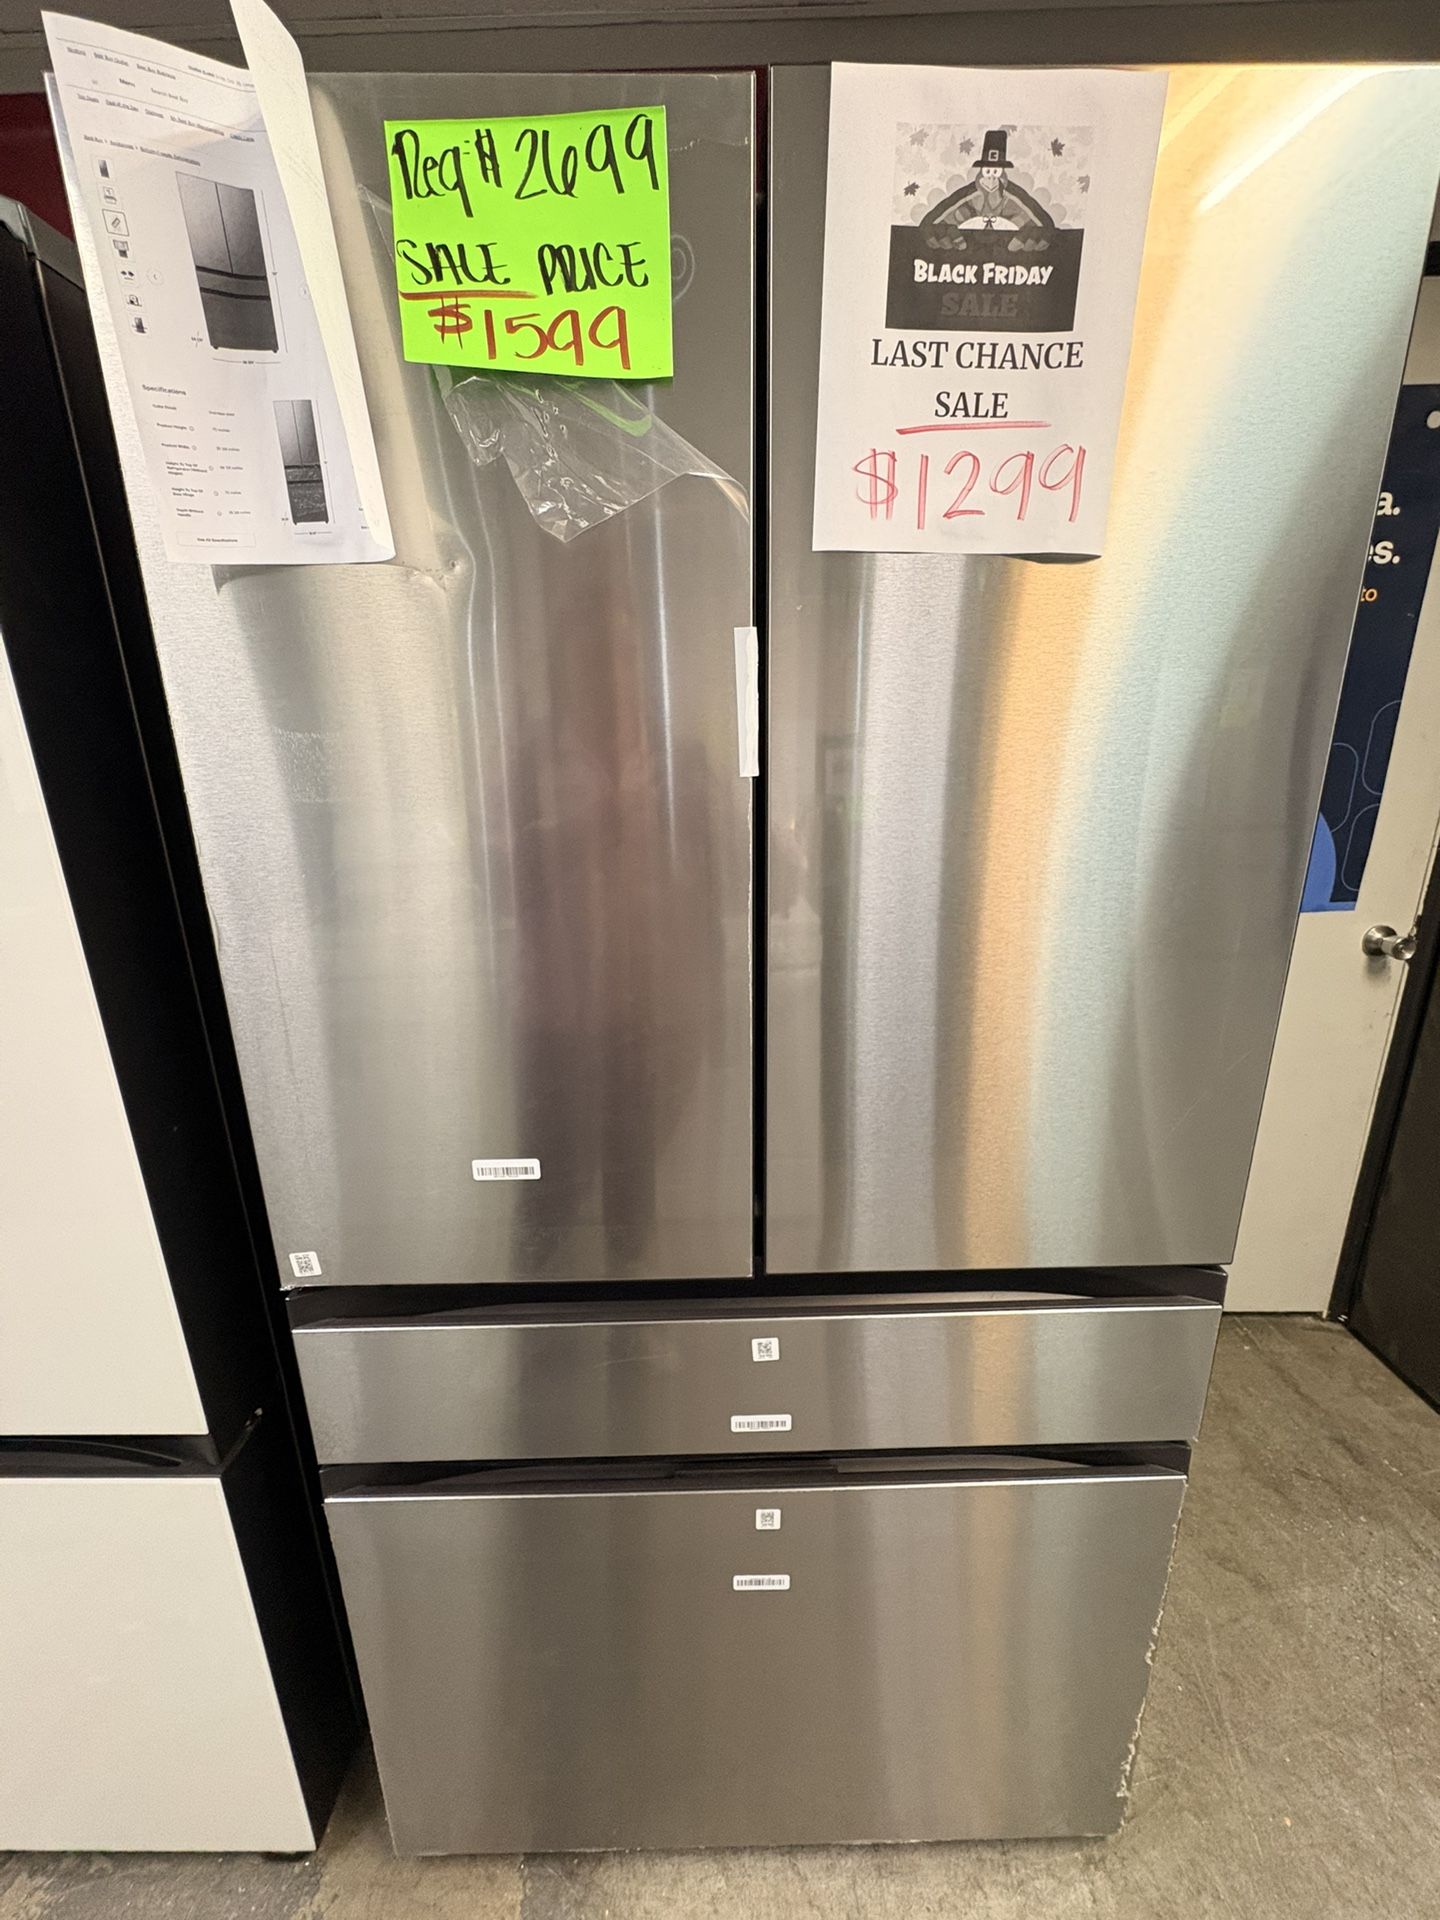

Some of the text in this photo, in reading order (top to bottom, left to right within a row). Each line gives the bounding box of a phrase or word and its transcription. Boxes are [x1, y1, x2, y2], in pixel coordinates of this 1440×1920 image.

[396, 239, 650, 296] SALE PRICE
[913, 259, 1054, 286] BLACK FRIDAY
[940, 292, 1020, 318] SALE
[427, 296, 632, 371] $1599
[871, 338, 1085, 370] LAST CHANCE
[934, 391, 1010, 419] SALE
[852, 443, 1087, 530] $1299
